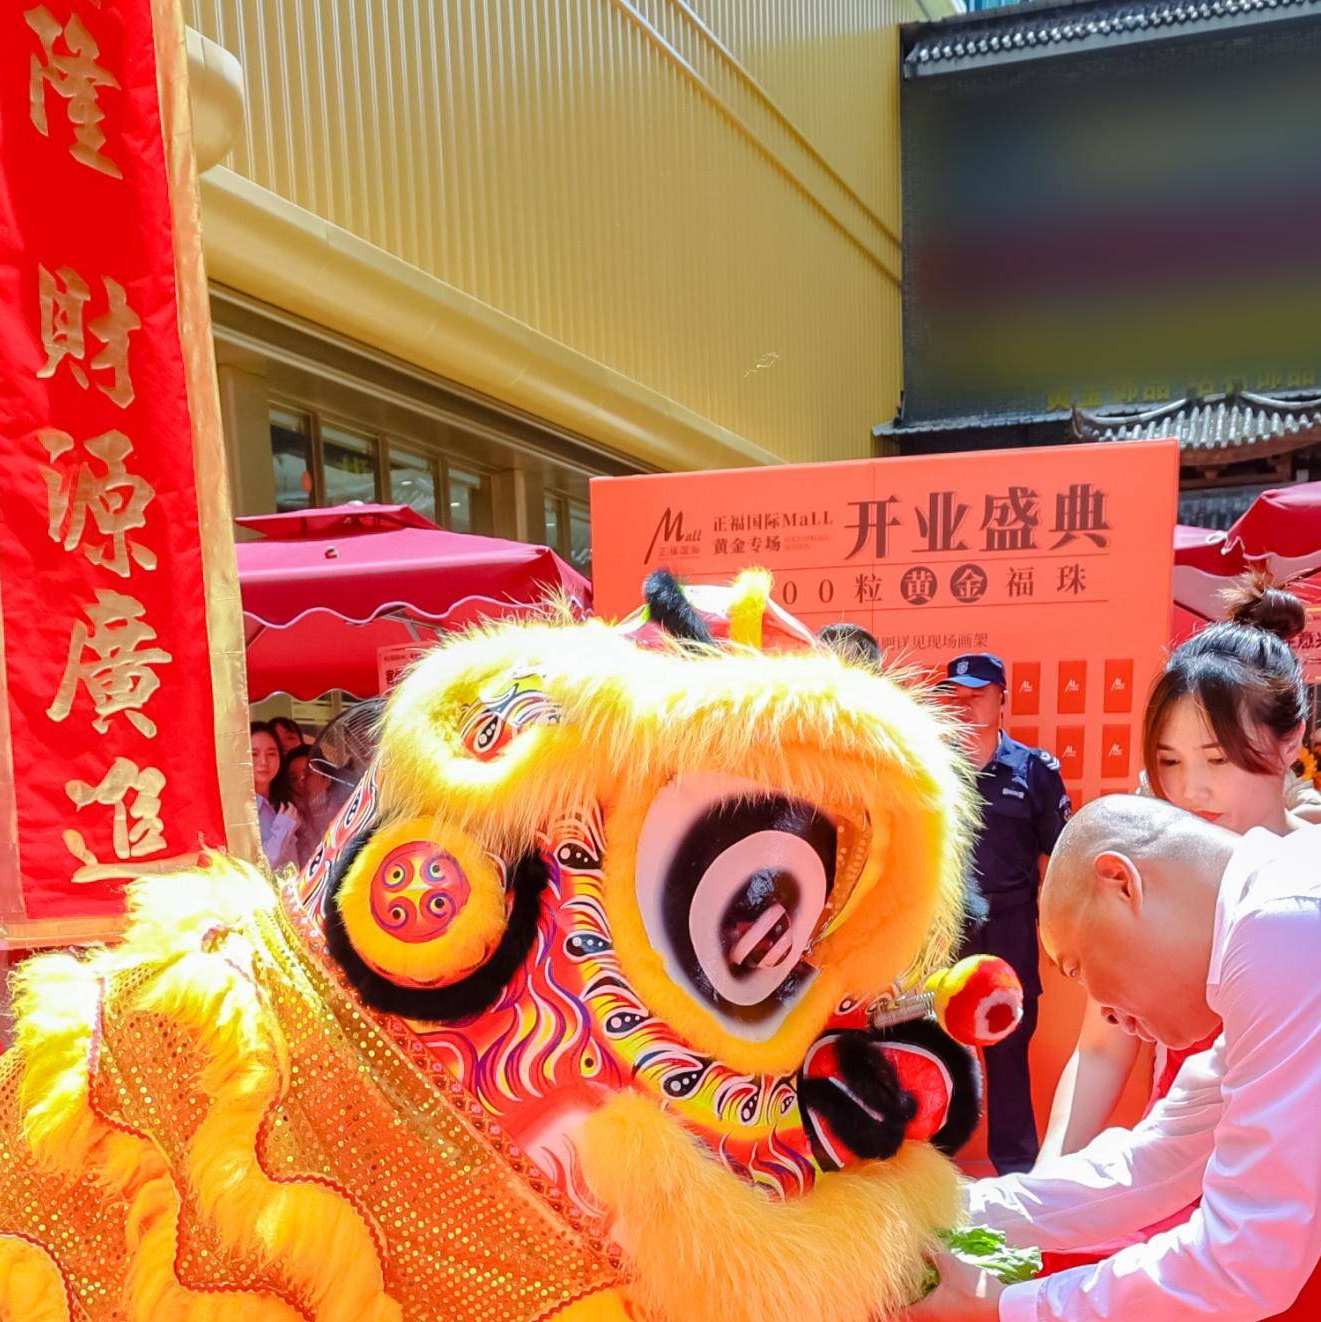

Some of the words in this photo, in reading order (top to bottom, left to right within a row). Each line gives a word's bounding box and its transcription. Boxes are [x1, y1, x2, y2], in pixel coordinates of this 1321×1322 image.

[713, 535, 782, 556] 黄金专场
[843, 483, 1111, 561] 开业盛典
